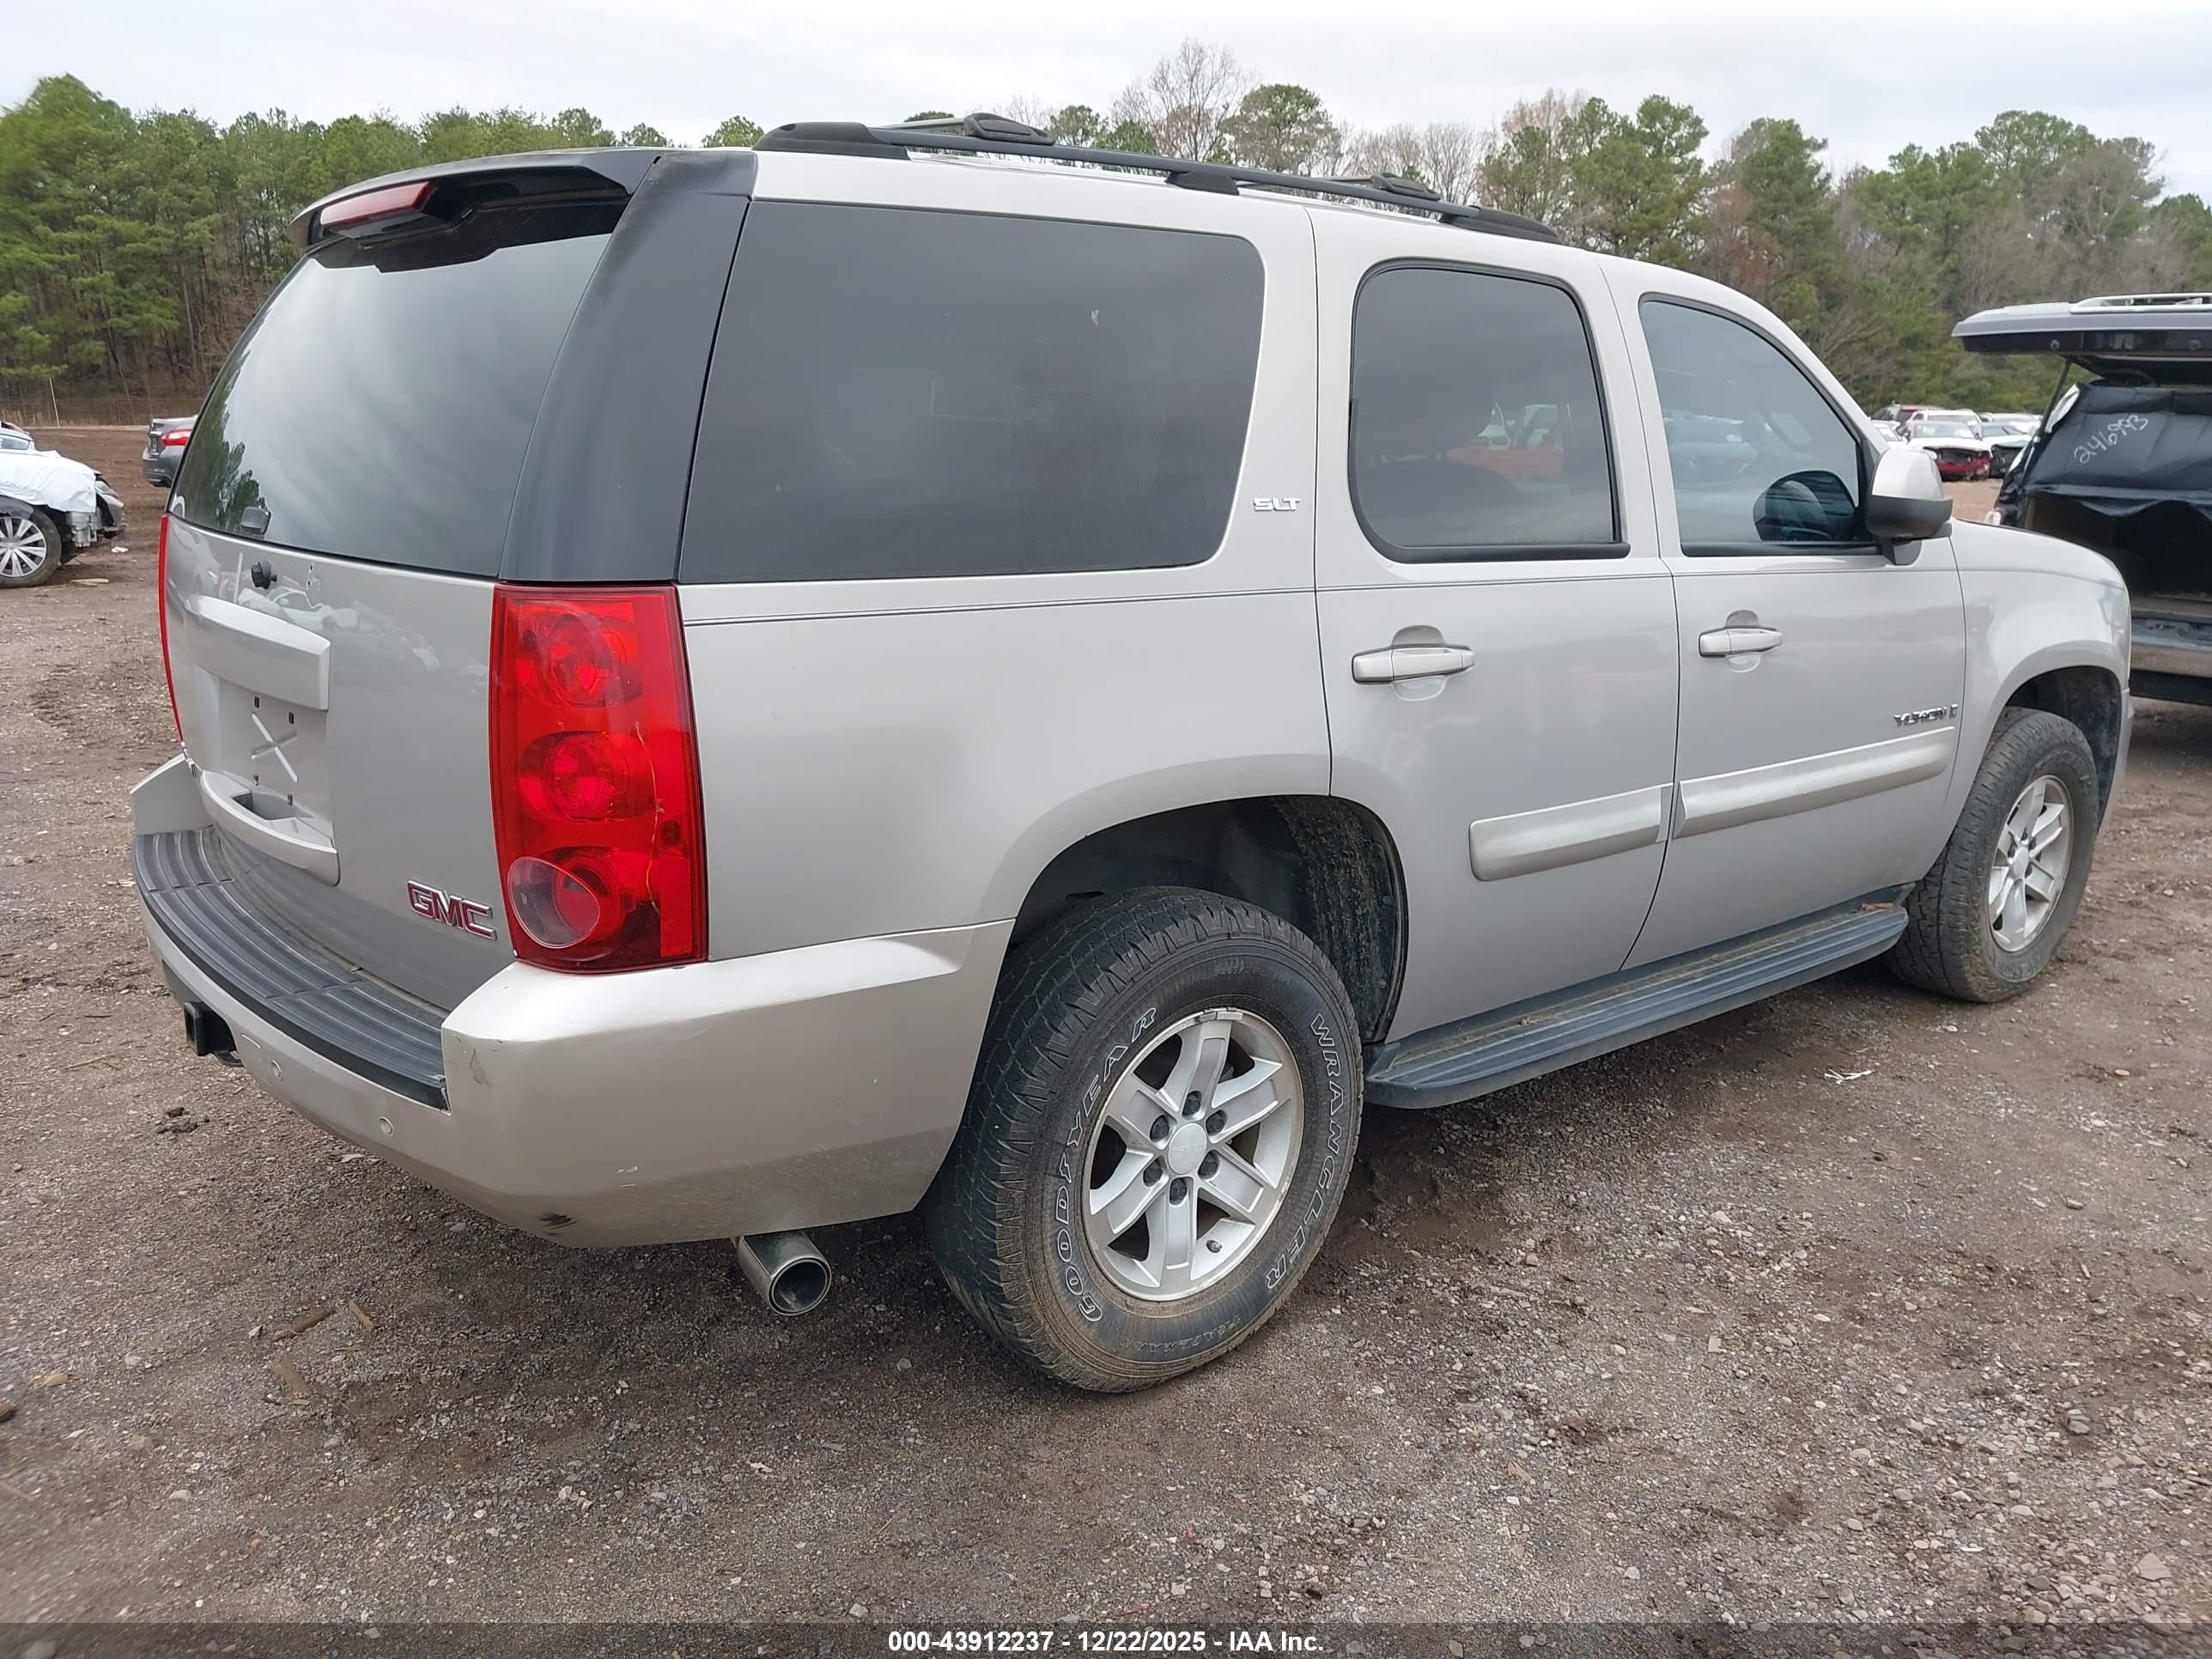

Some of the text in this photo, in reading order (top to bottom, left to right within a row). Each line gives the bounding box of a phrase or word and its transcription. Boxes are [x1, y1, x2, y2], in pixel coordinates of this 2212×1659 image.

[1253, 497, 1301, 512] SLT
[407, 879, 497, 941] GMC
[1055, 1007, 1157, 1322] GOODYEAR
[1266, 1012, 1345, 1290] WRANGLER
